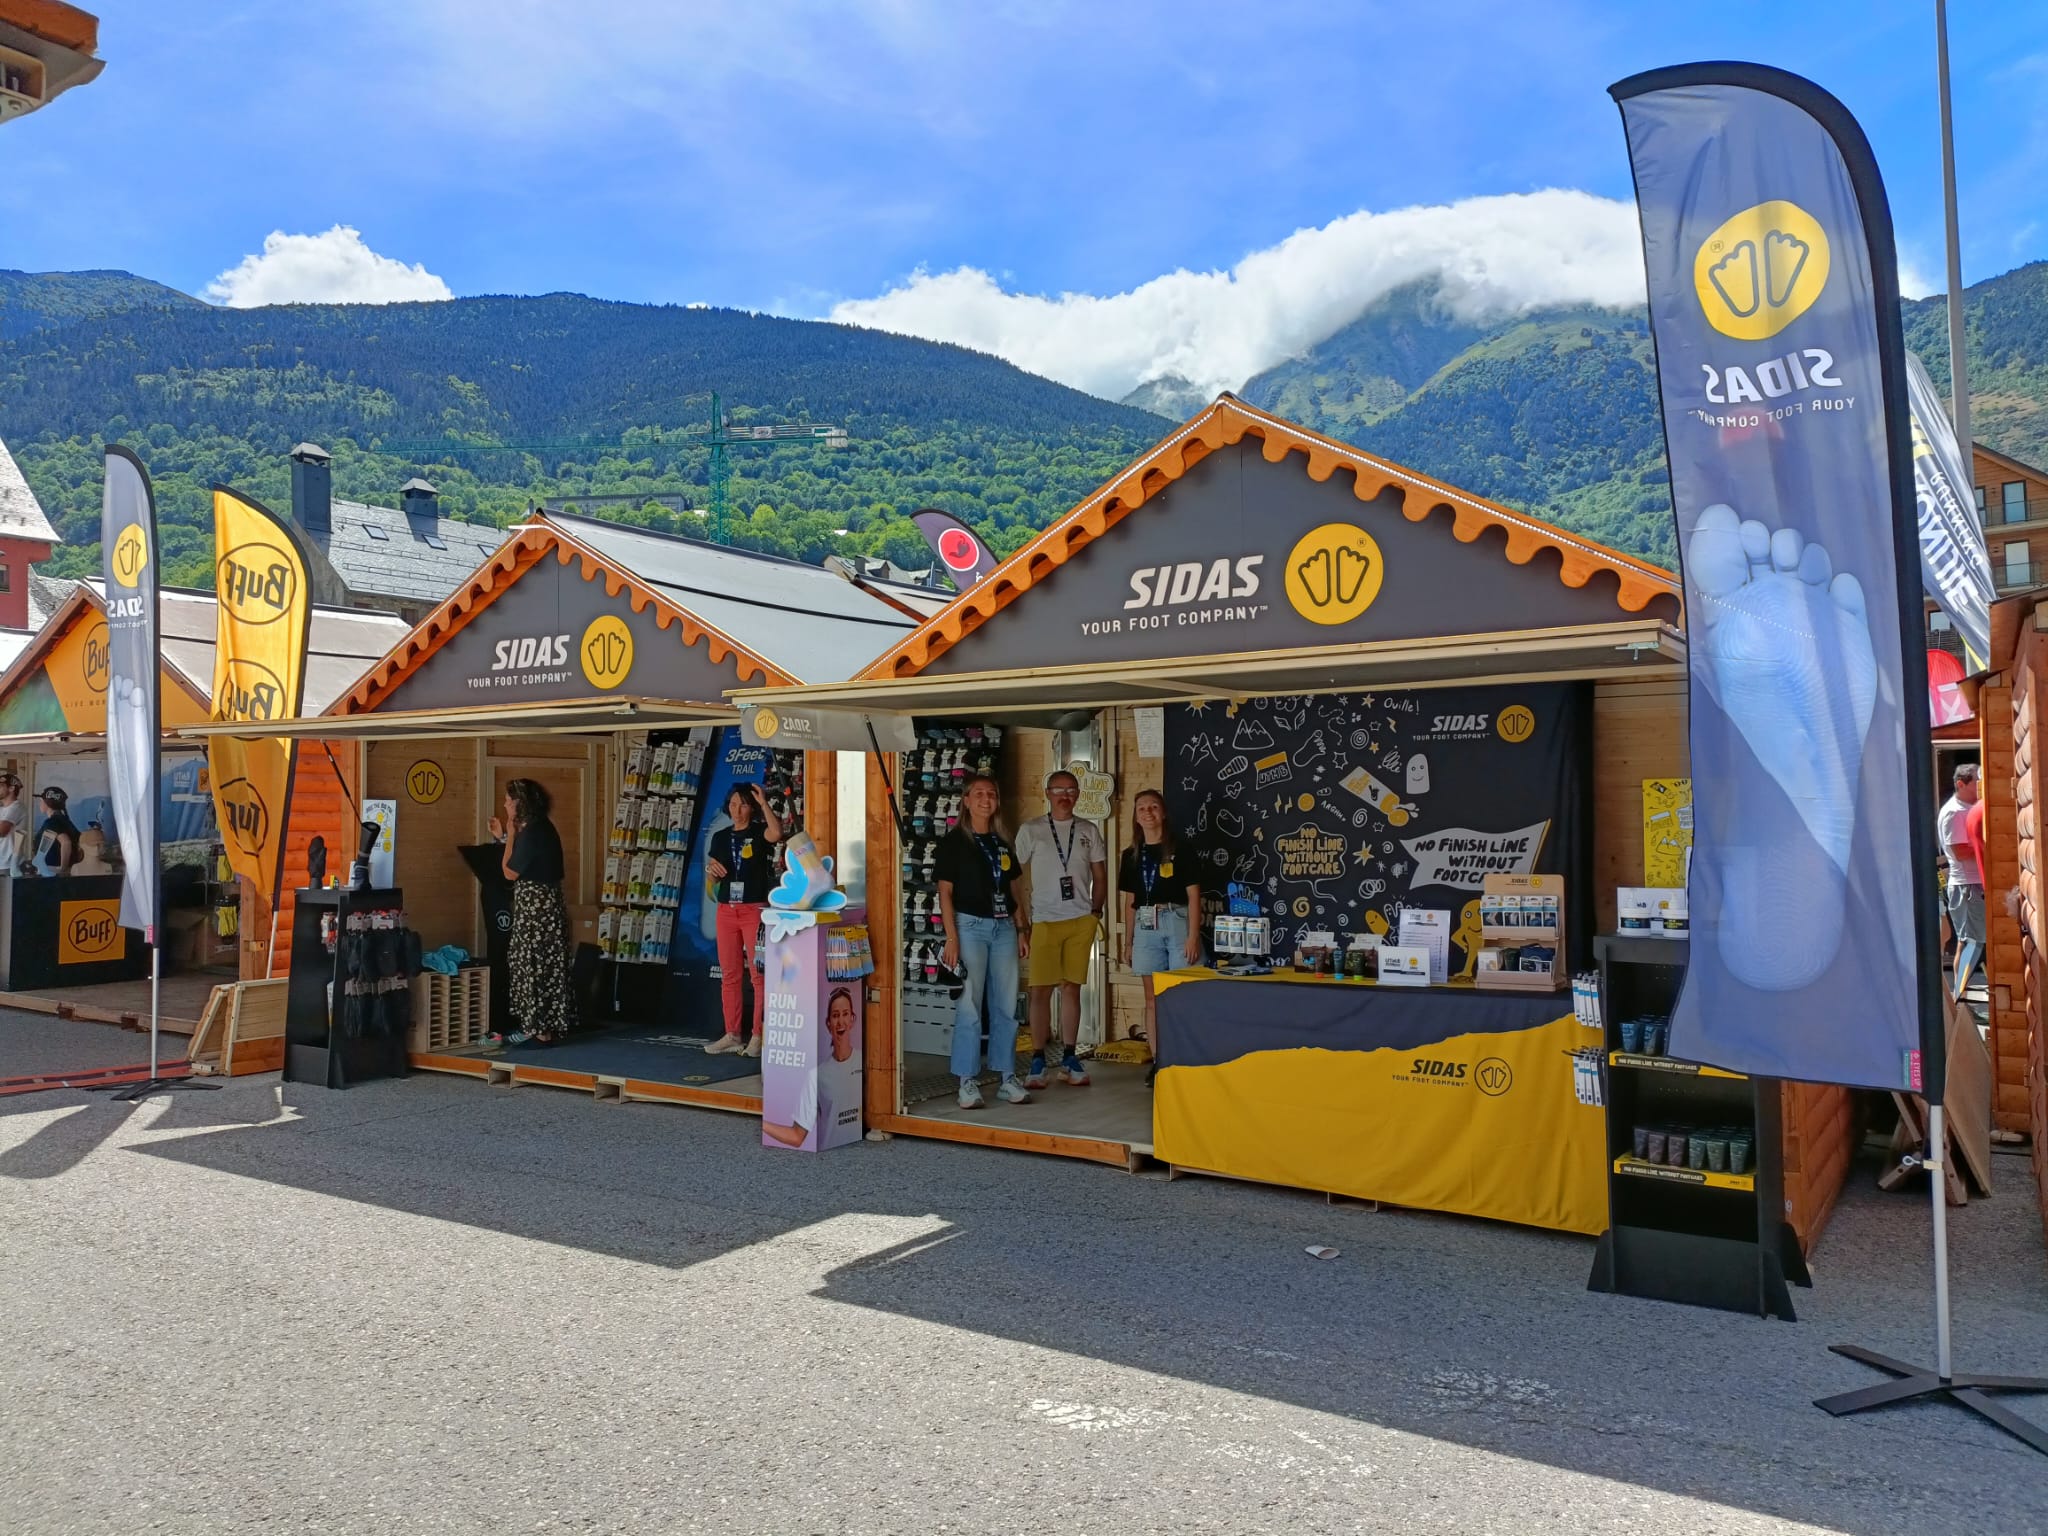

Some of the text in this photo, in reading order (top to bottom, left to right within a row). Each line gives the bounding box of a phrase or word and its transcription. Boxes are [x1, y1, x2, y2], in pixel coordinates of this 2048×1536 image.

[1123, 554, 1264, 610] SIDAS
[1081, 620, 1122, 636] YOUR
[1129, 614, 1170, 631] FOOT
[491, 634, 571, 670] SIDAS
[467, 677, 491, 689] YOUR
[495, 676, 518, 687] FOOT
[1430, 714, 1488, 732] SIDAS
[725, 748, 766, 763] 3Feet
[731, 764, 756, 775] TRAIL
[1300, 827, 1317, 839] NO
[1415, 840, 1436, 852] NO
[1282, 862, 1341, 876] FOOTCARE
[1433, 868, 1511, 884] FOOTC
[768, 992, 797, 1010] RUN
[767, 1011, 804, 1029] BOLD
[767, 1030, 797, 1047] RUN
[767, 1048, 806, 1067] FREE!
[1410, 1059, 1468, 1078] SIDAS
